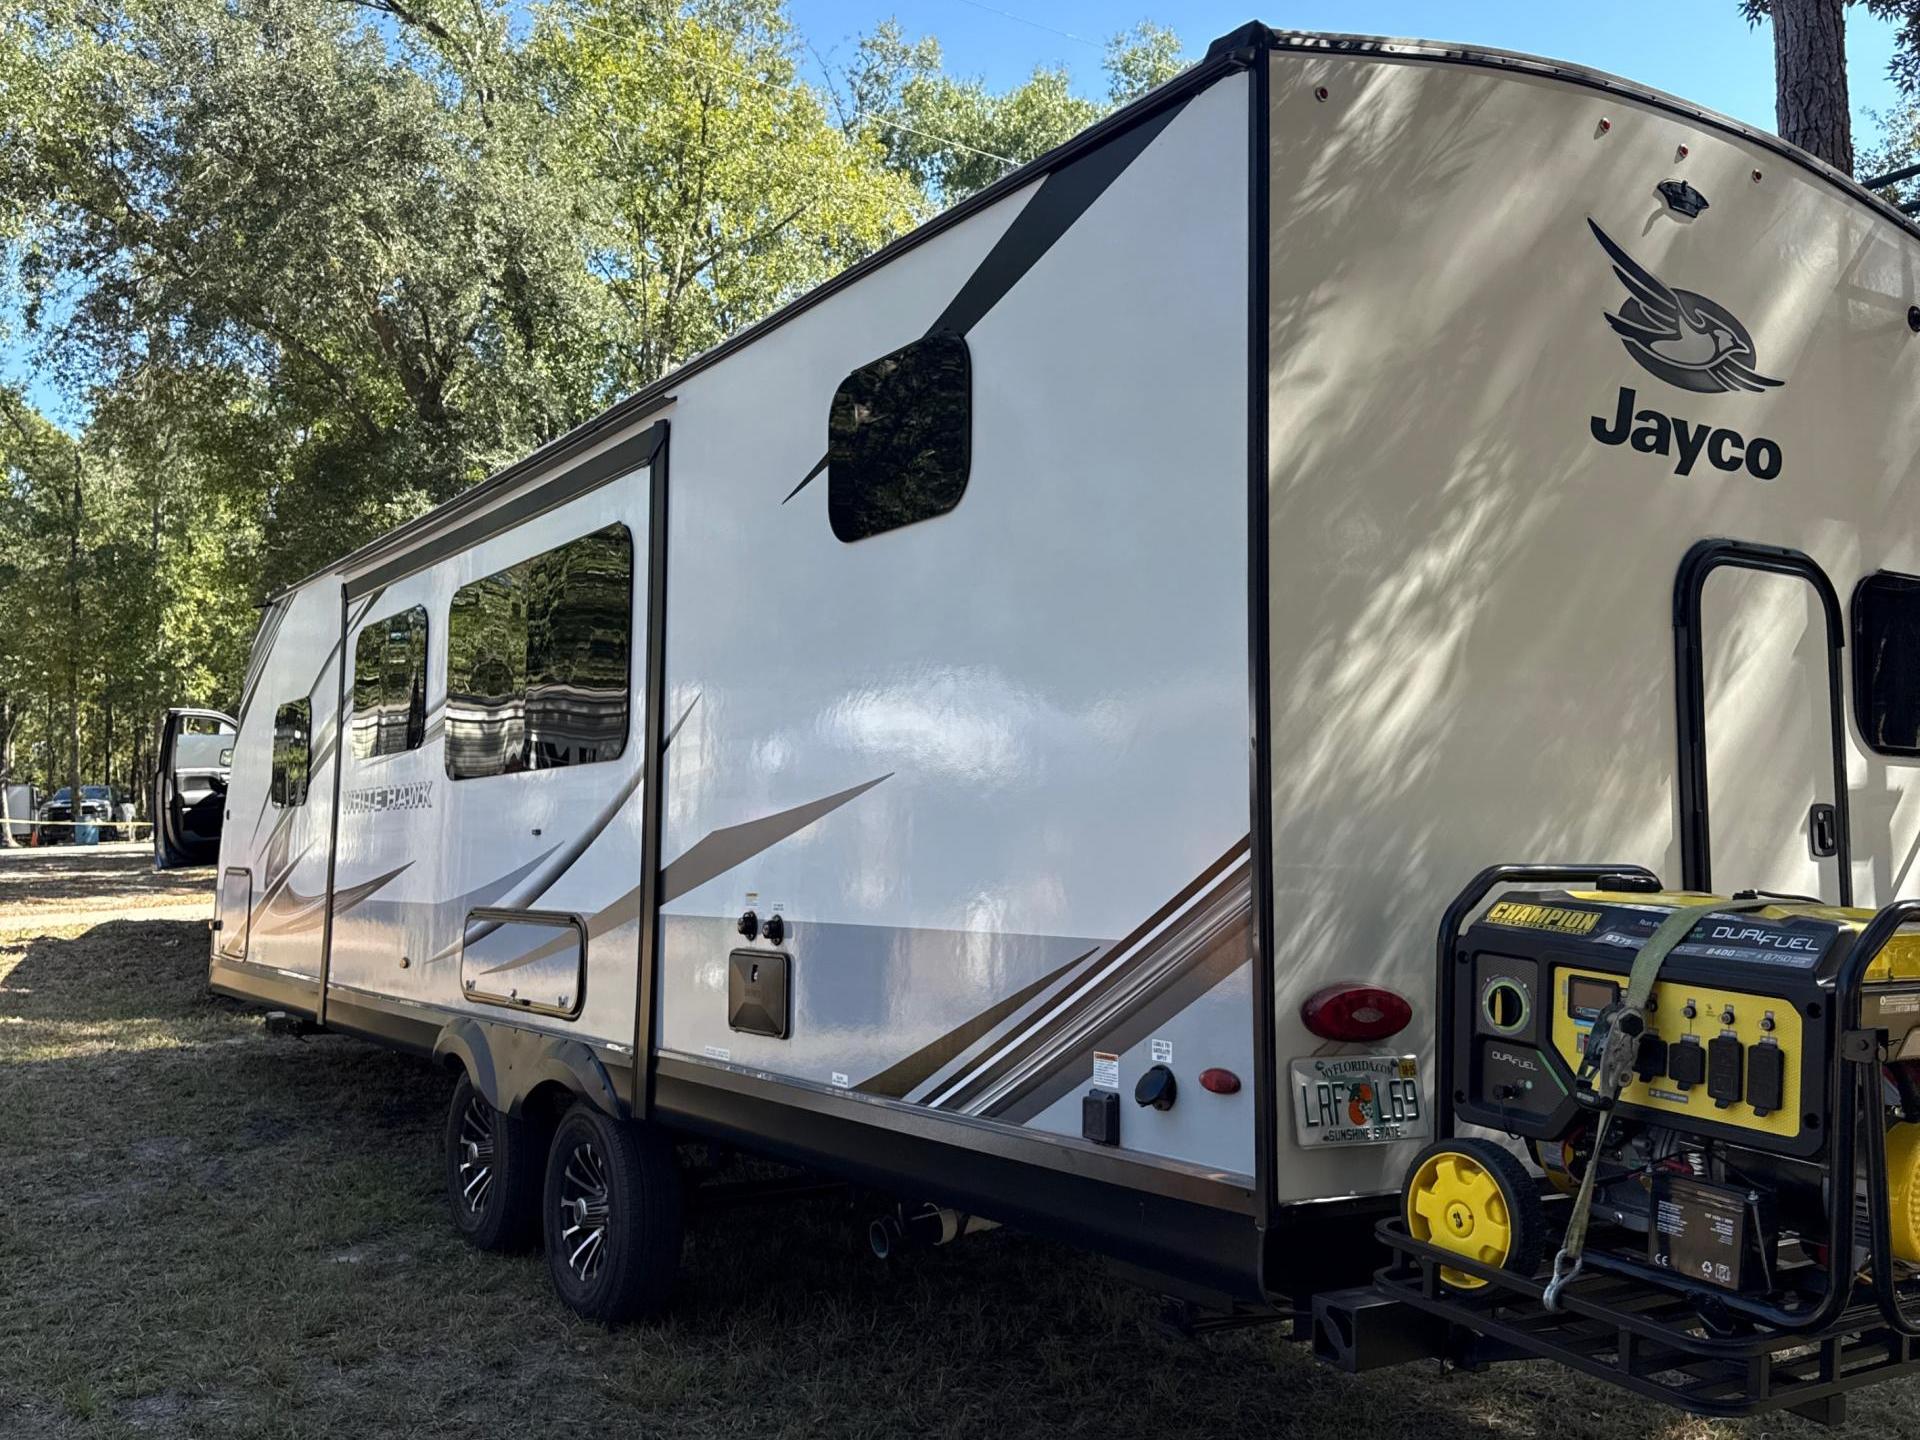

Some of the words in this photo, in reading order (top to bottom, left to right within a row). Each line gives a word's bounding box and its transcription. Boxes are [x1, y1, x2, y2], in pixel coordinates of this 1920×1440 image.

[1590, 386, 1782, 480] Jayco
[342, 787, 382, 815] WHITE
[386, 781, 433, 811] HAWK
[1490, 903, 1599, 930] CHAMPION
[1321, 1060, 1394, 1079] MYFLORIDA.COM
[1374, 1078, 1420, 1123] L69
[1328, 1127, 1371, 1142] SUNSHINE
[1374, 1126, 1401, 1140] STATE
